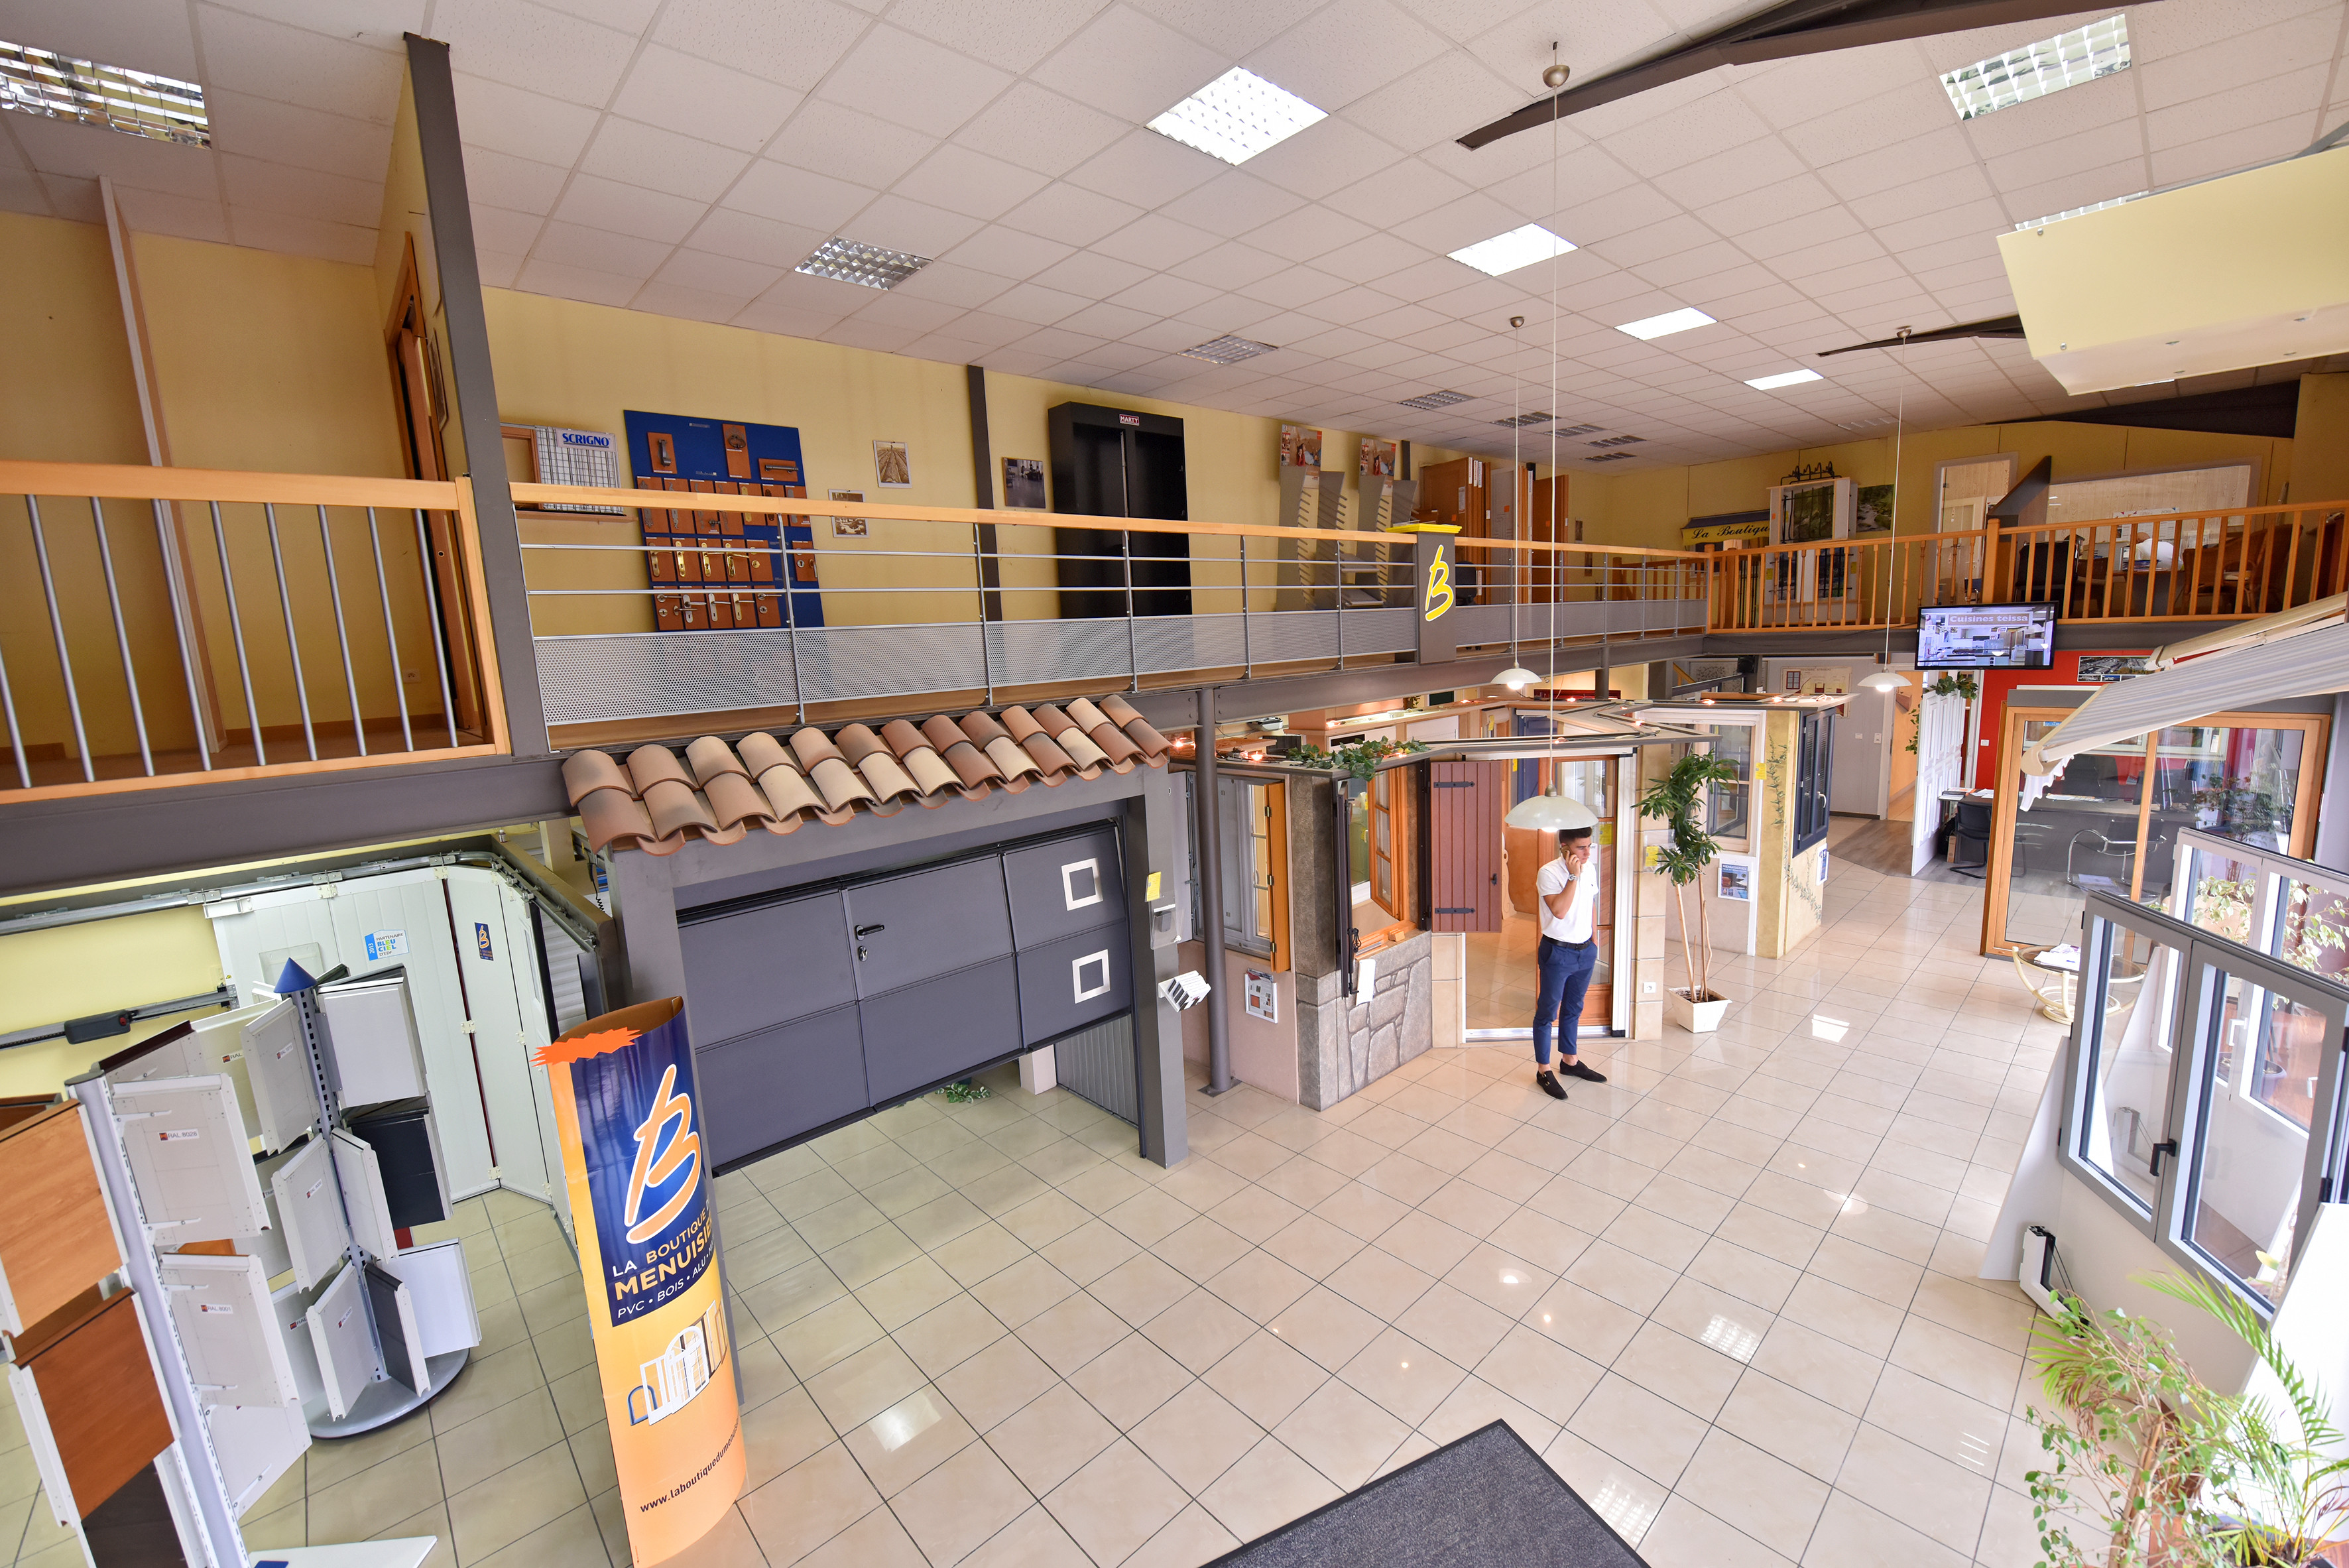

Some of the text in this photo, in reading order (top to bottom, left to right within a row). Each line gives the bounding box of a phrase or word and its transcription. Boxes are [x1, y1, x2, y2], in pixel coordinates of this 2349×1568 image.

[562, 433, 609, 447] SCRIGNO
[1691, 524, 1770, 539] La Boutiqu
[1425, 544, 1454, 622] B
[376, 932, 403, 941] PARTENAIRE
[624, 1063, 701, 1244] B
[613, 1260, 637, 1277] LA
[646, 1208, 707, 1264] BOUTIQUE
[618, 1258, 706, 1318] PVC BOIS ALU
